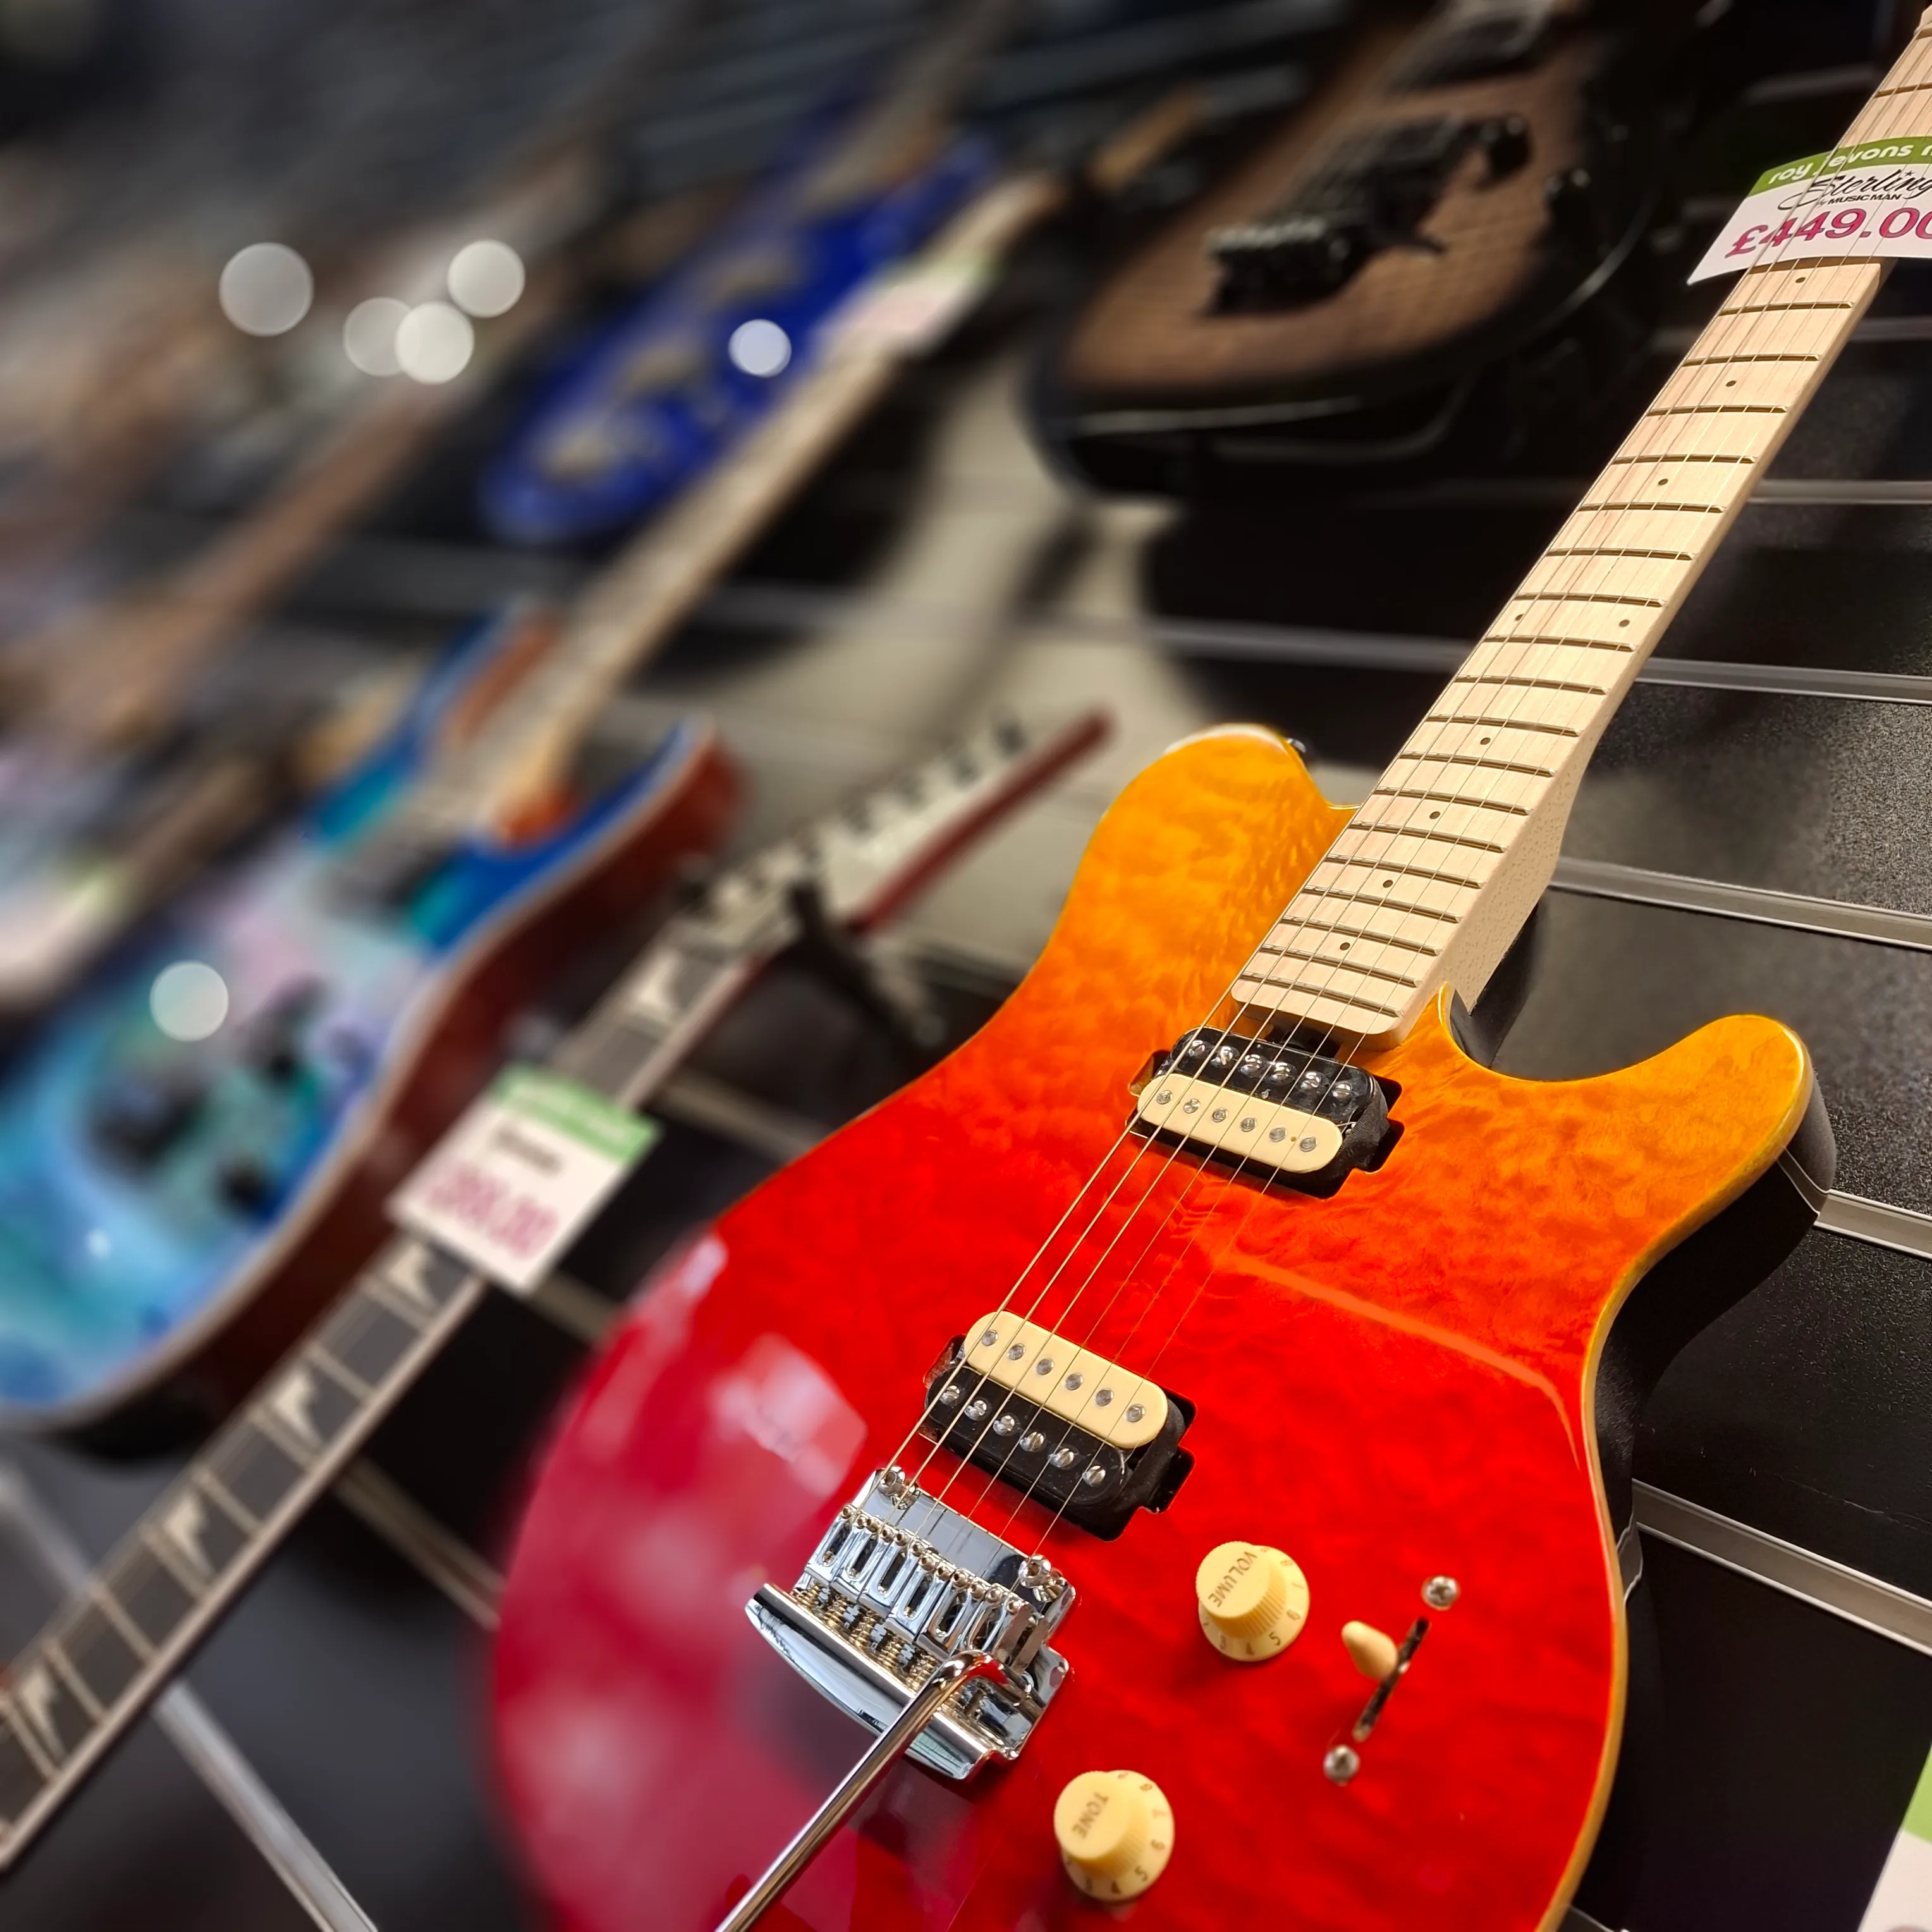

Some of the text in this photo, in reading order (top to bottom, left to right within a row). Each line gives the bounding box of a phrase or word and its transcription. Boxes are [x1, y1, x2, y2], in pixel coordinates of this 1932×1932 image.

[1768, 162, 1814, 184] roy
[1208, 1551, 1257, 1608] VOLUME
[1268, 1631, 1281, 1646] 5
[1072, 1792, 1109, 1838] TONE
[1134, 1866, 1149, 1882] 5
